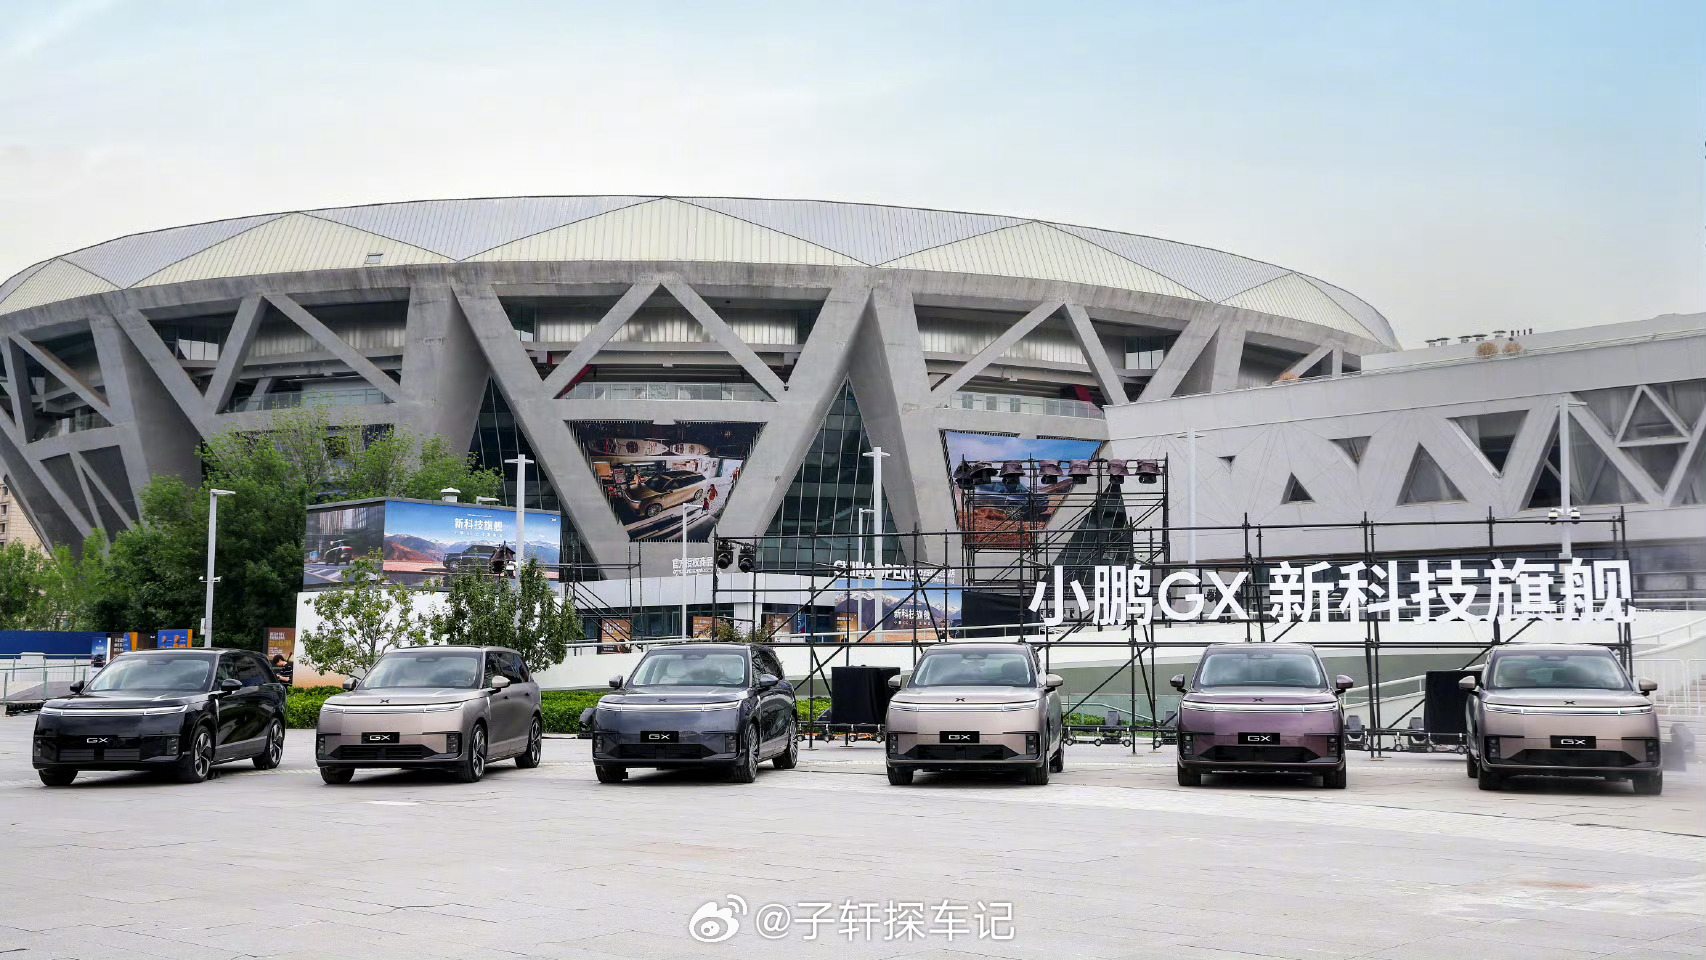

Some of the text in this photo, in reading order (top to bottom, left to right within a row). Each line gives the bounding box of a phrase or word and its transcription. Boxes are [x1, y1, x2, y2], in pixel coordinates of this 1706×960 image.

[454, 518, 503, 532] 新科技旗舰
[877, 563, 911, 580] PEN
[1028, 558, 1636, 626] 小鹏GX 新科技旗舰
